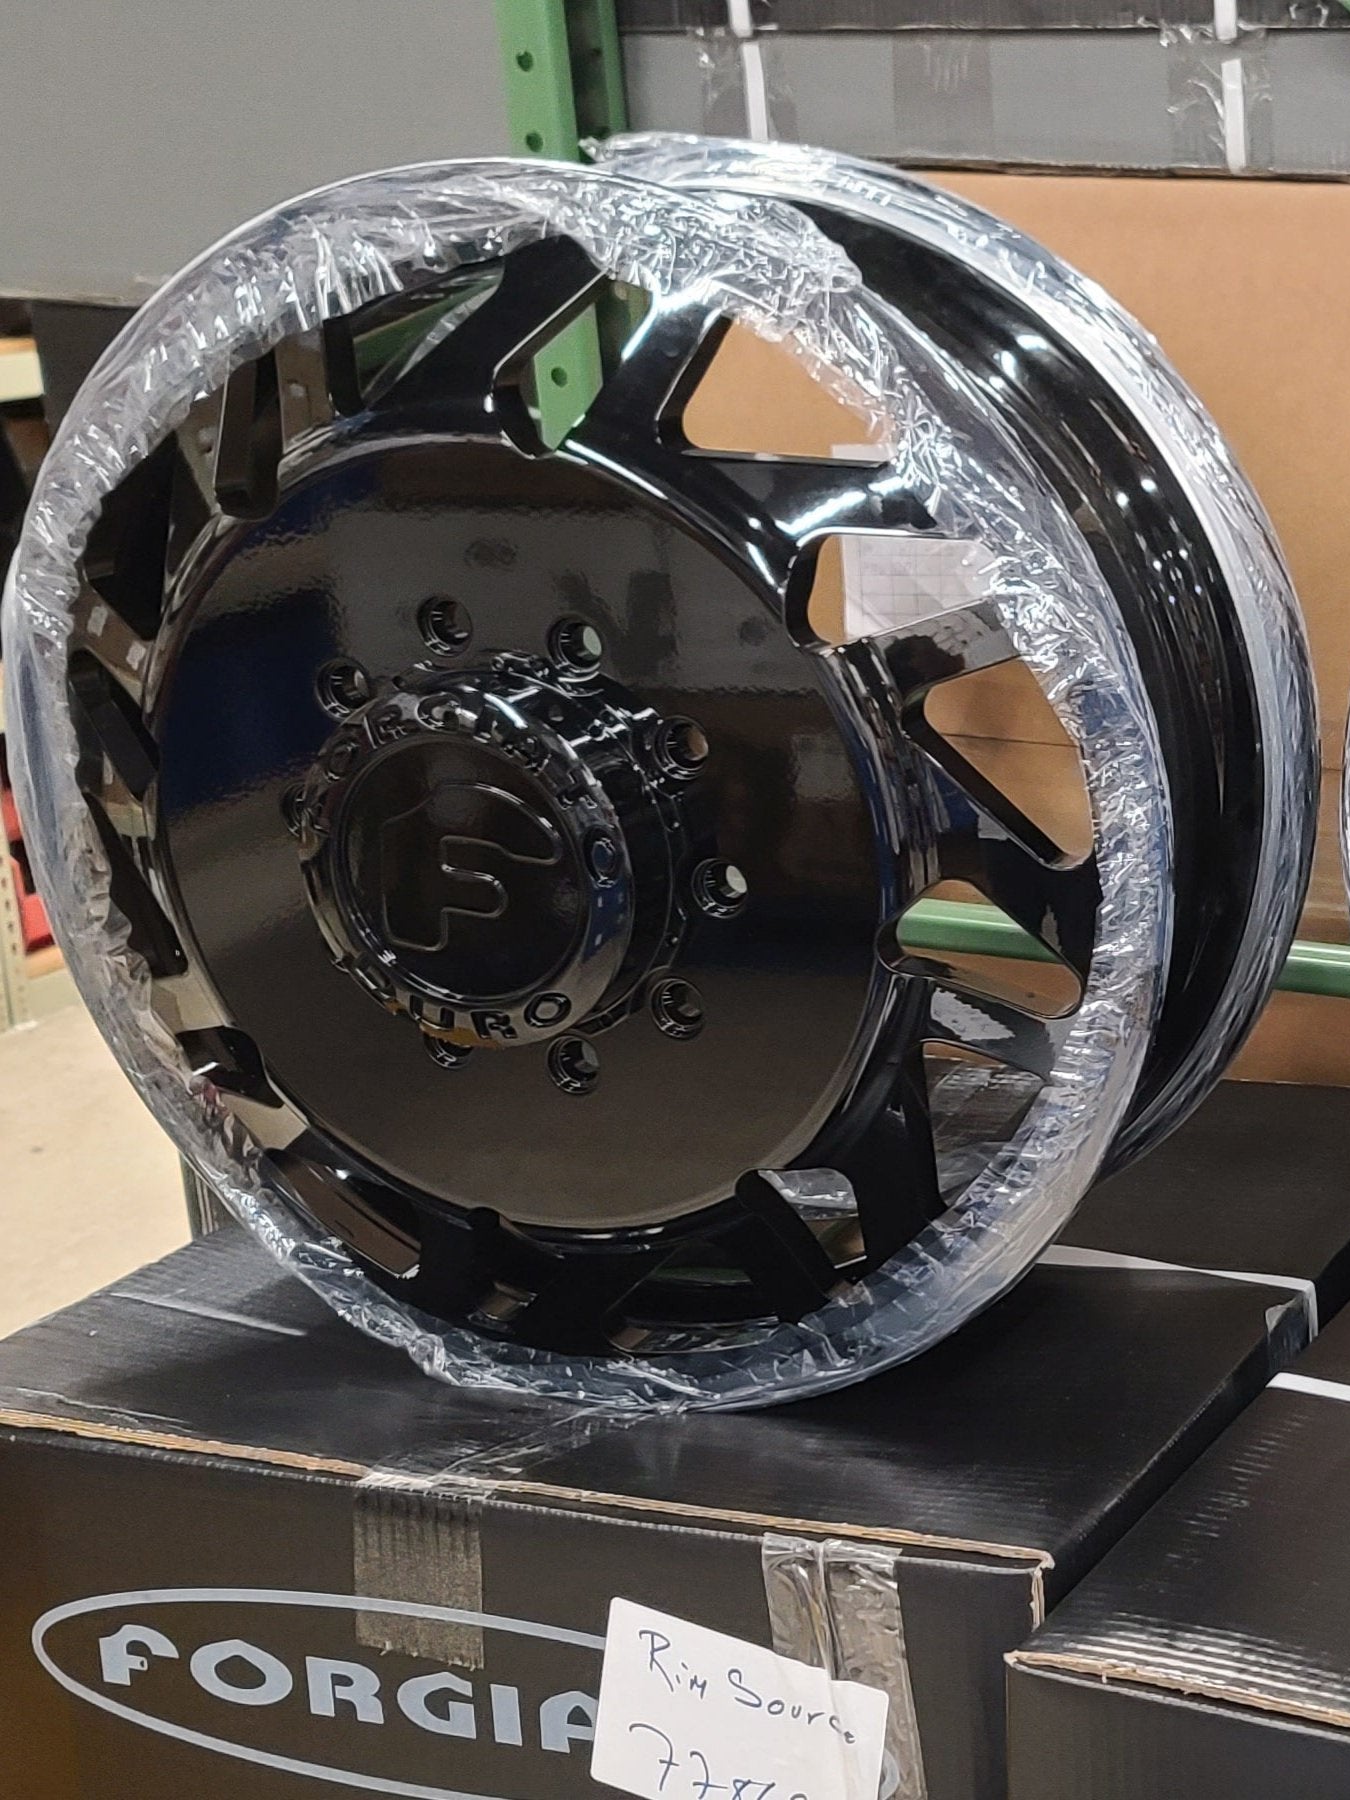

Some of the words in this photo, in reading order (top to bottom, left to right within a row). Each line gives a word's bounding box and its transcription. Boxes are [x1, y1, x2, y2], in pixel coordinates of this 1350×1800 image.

[98, 1623, 598, 1754] FORGIA
[638, 1628, 708, 1699] Rim
[727, 1668, 856, 1744] Source
